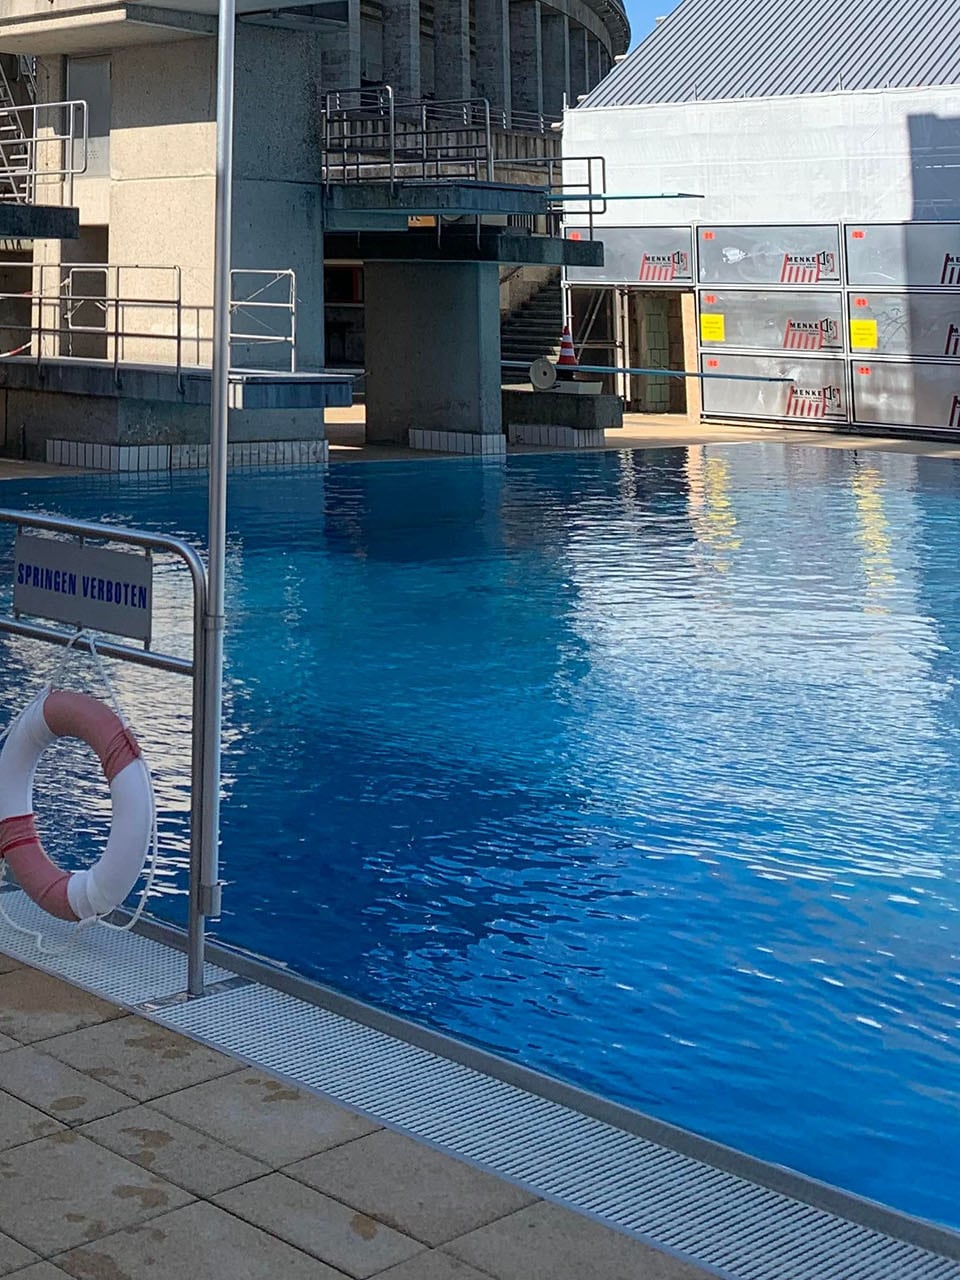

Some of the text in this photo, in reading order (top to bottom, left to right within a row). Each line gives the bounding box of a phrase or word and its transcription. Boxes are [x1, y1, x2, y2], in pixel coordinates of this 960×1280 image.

[792, 389, 823, 397] MENKE
[17, 563, 147, 609] SPRINGEN VERBOTEN
